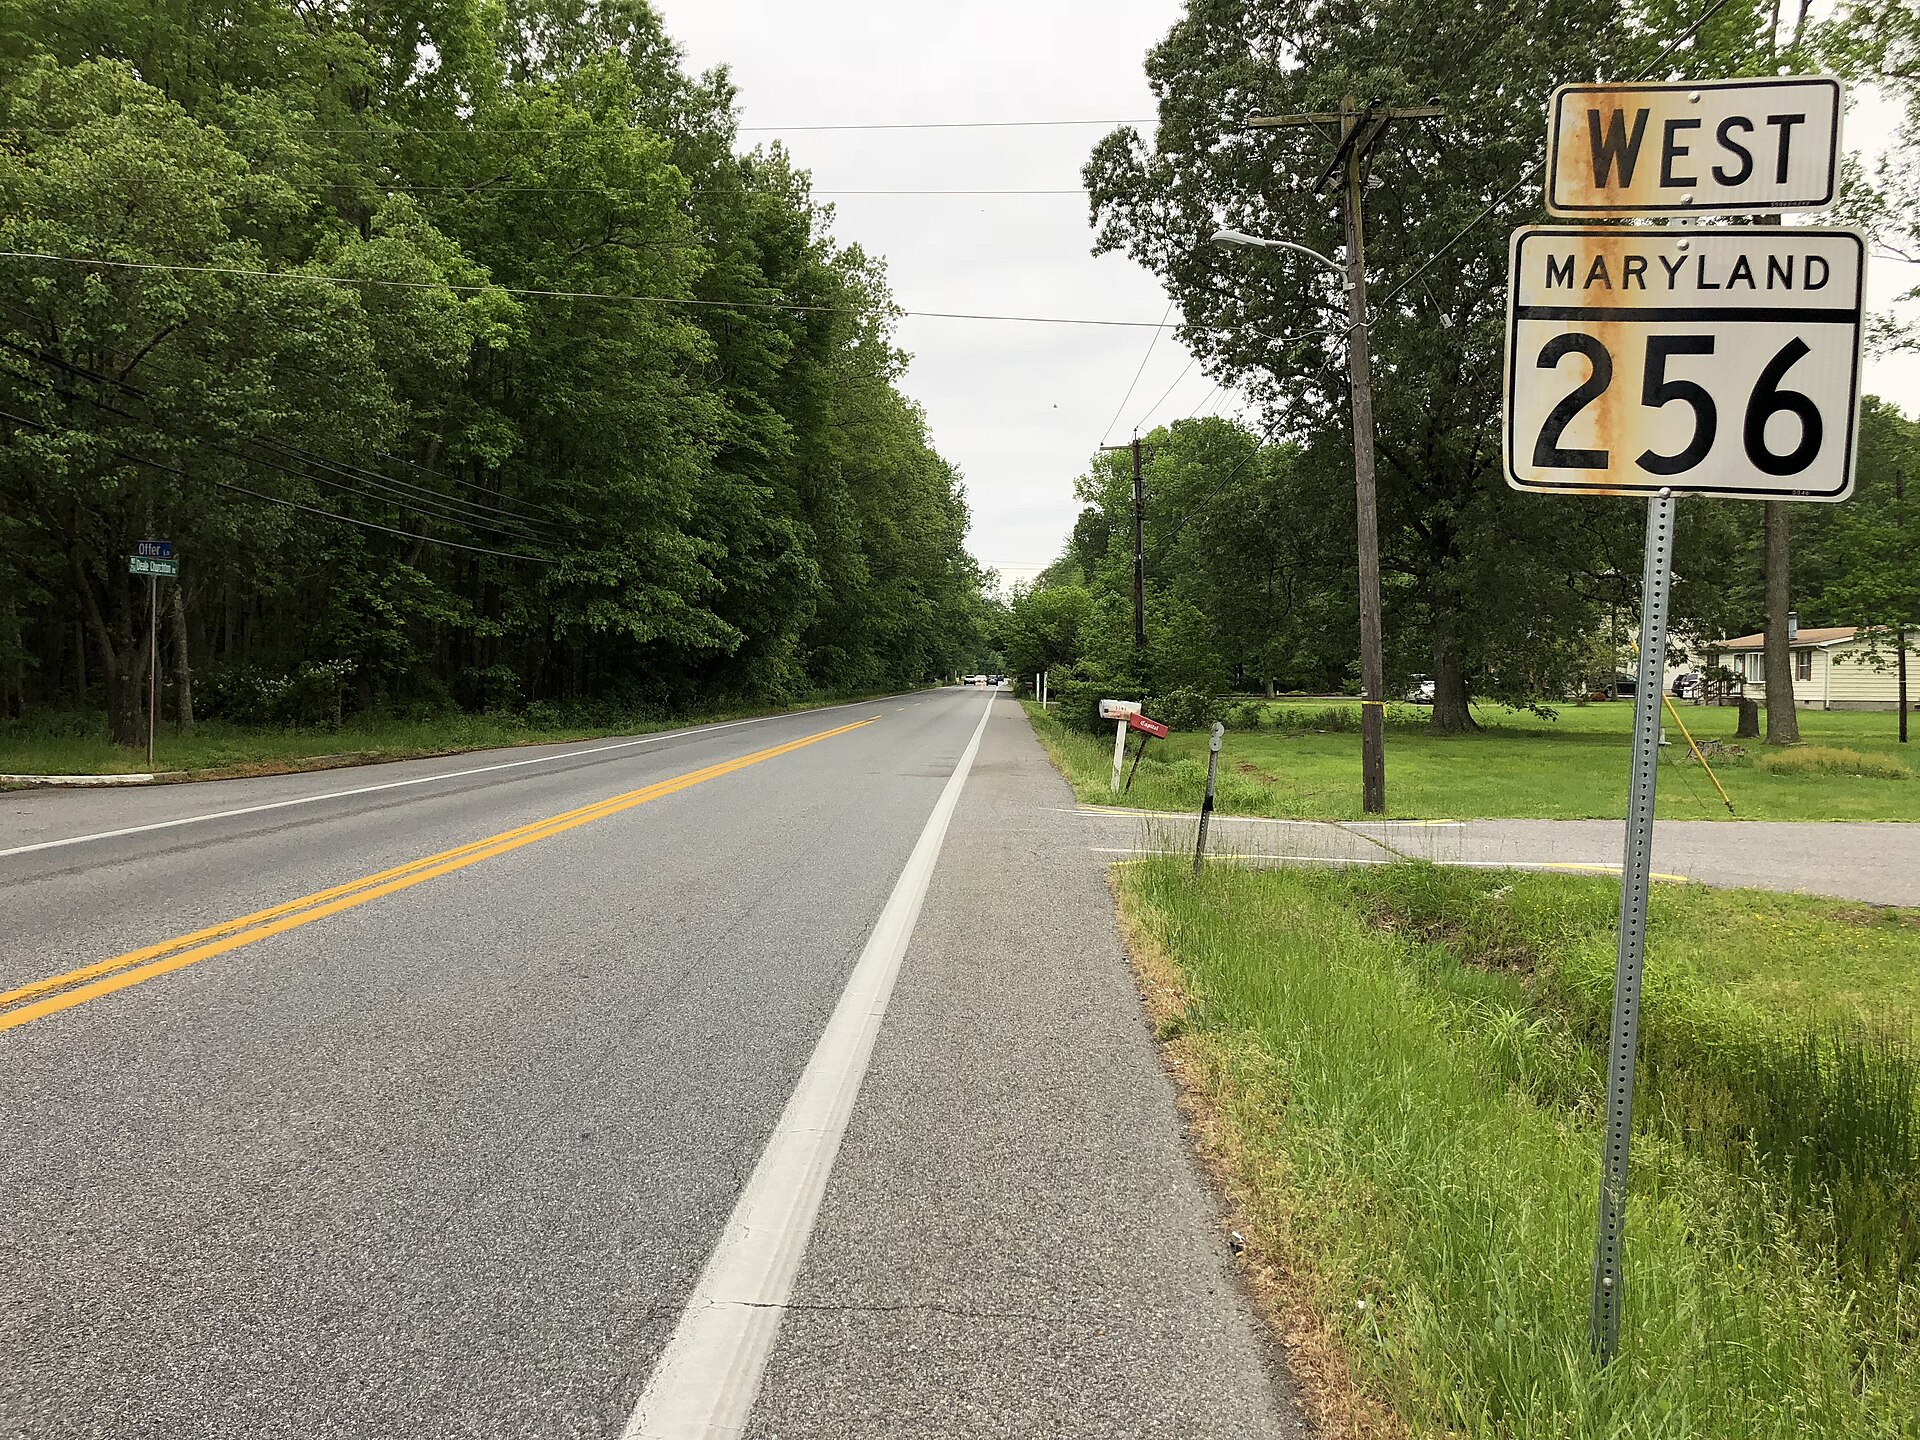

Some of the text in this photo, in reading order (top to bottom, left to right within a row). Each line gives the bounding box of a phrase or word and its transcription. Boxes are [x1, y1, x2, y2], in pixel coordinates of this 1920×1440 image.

[1587, 108, 1806, 188] WEST
[1545, 254, 1830, 290] MARYLAND
[1532, 332, 1823, 476] 256
[138, 543, 161, 556] Offer
[1139, 720, 1160, 731] Capital
